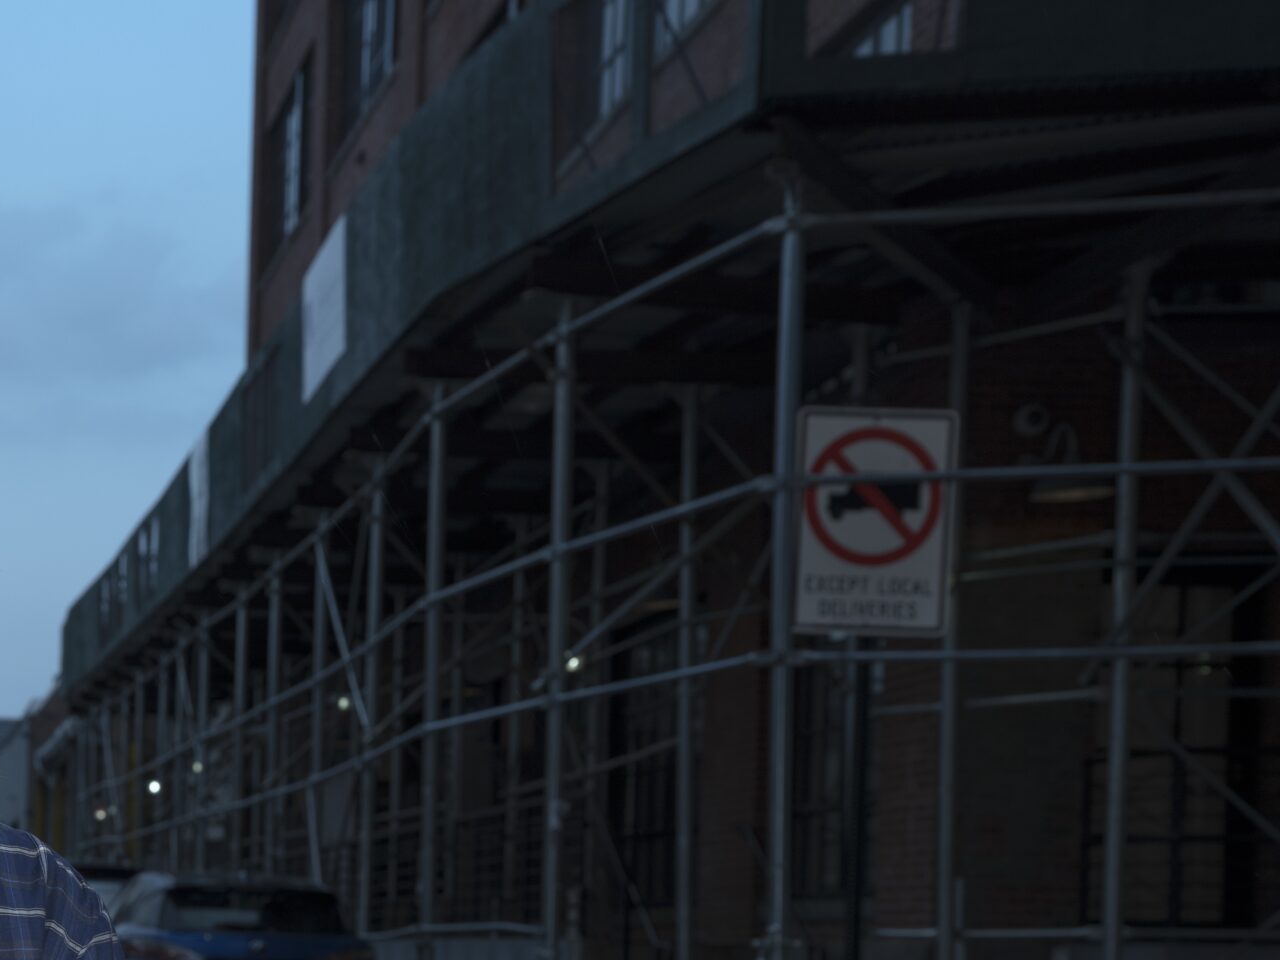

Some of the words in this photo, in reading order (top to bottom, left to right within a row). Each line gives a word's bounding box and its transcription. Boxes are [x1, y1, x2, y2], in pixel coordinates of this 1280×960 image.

[805, 574, 869, 593] EXCEPT
[878, 576, 933, 596] LOCAL
[818, 600, 918, 620] DELIVERIES
